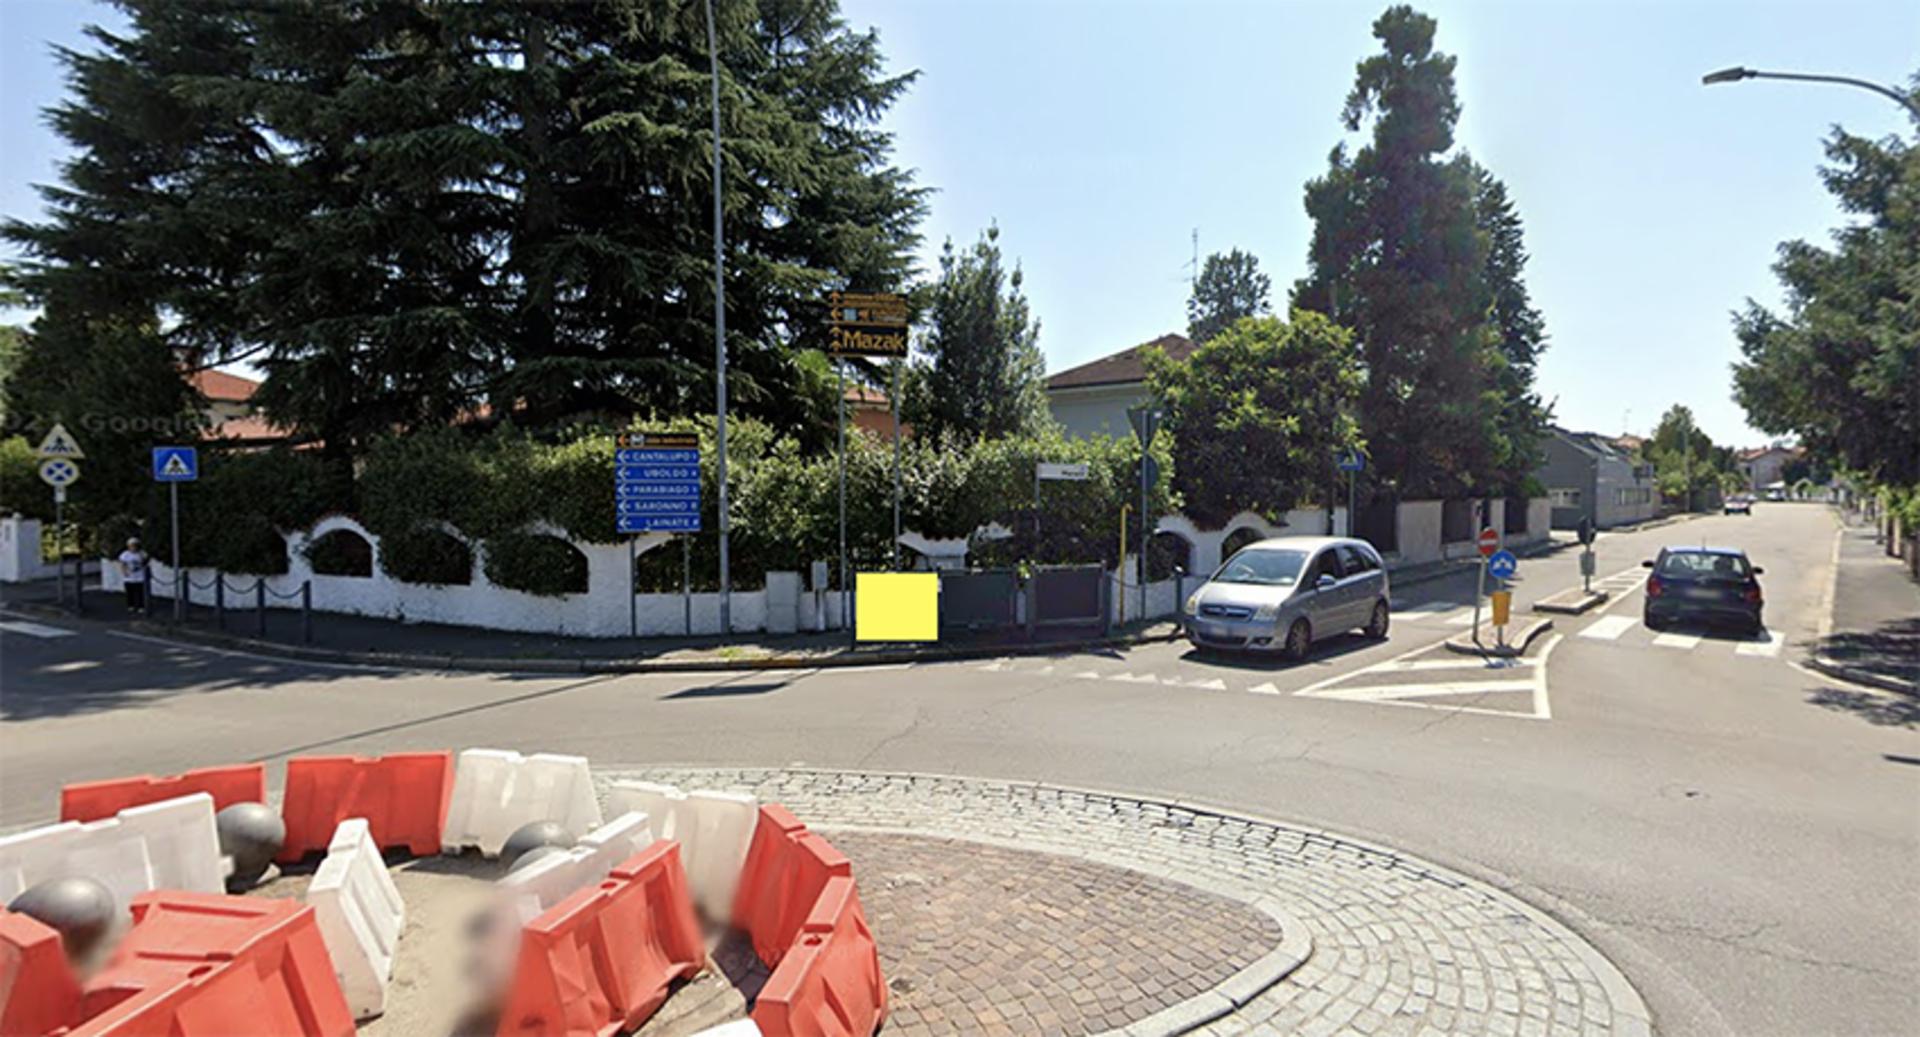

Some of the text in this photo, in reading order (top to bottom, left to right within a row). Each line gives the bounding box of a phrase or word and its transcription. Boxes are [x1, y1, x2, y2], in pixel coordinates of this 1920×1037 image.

[843, 330, 905, 350] Mazak
[632, 452, 690, 461] CANTALUPO
[643, 468, 688, 478] UBOLDO
[633, 485, 689, 494] PARABIAGO
[635, 501, 688, 511] SARONNO
[645, 518, 689, 527] LAINATE
